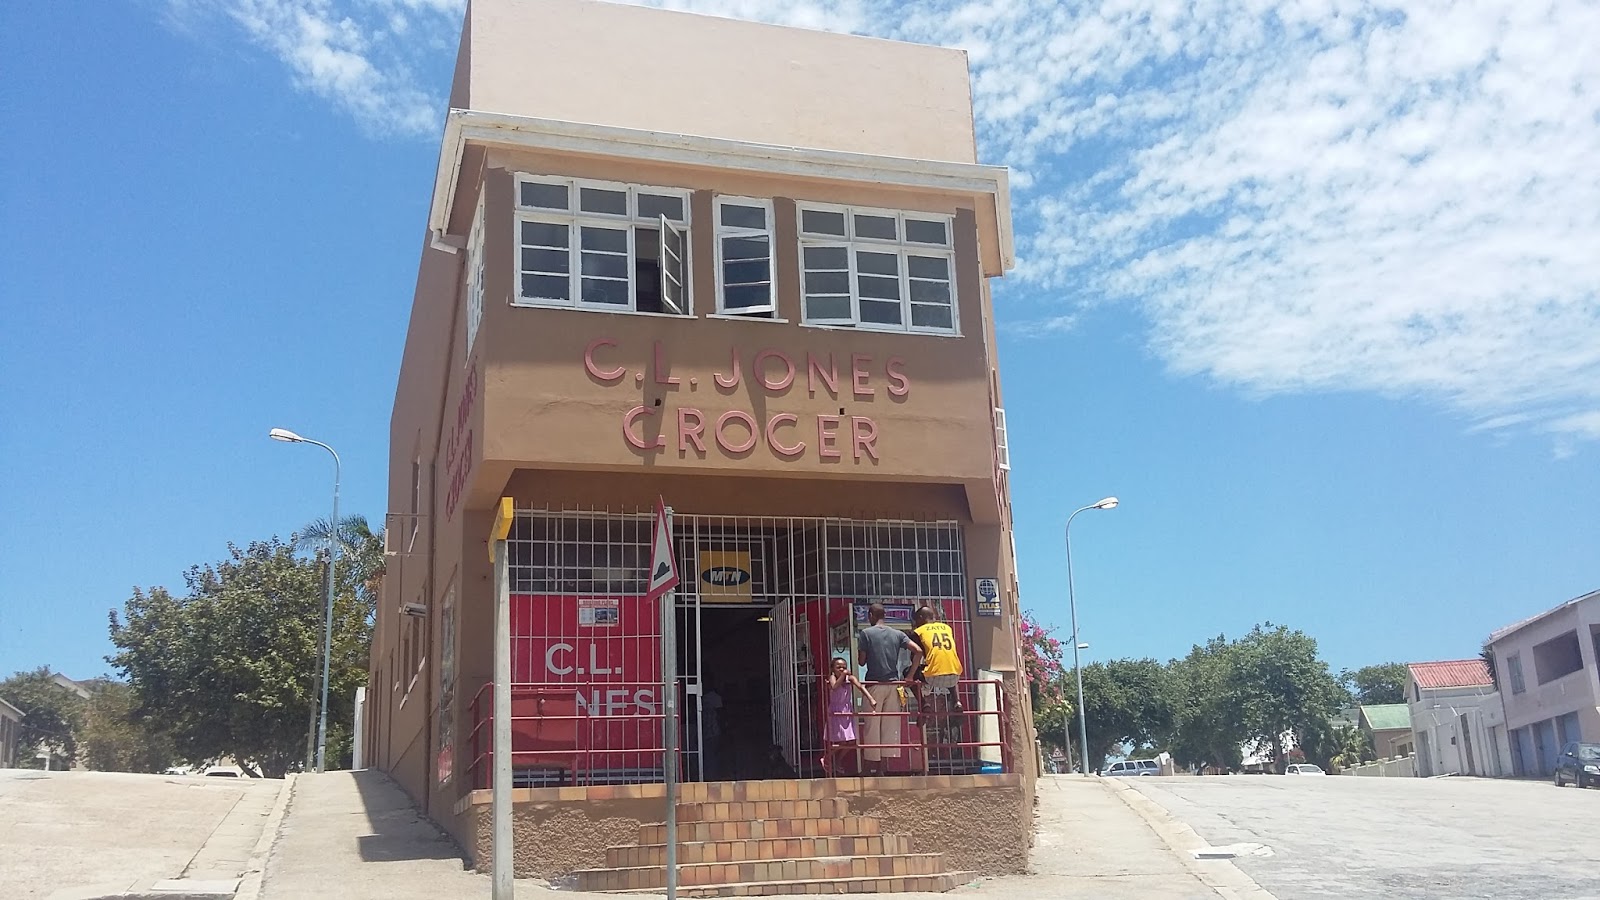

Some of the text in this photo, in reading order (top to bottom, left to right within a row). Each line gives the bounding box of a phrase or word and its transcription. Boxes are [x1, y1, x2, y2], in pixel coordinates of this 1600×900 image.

[584, 338, 910, 396] C.L. JONES
[623, 405, 880, 460] GROCER
[711, 570, 742, 582] MTN
[932, 632, 952, 650] 45
[546, 643, 622, 675] C.L.
[576, 689, 656, 722] NES
